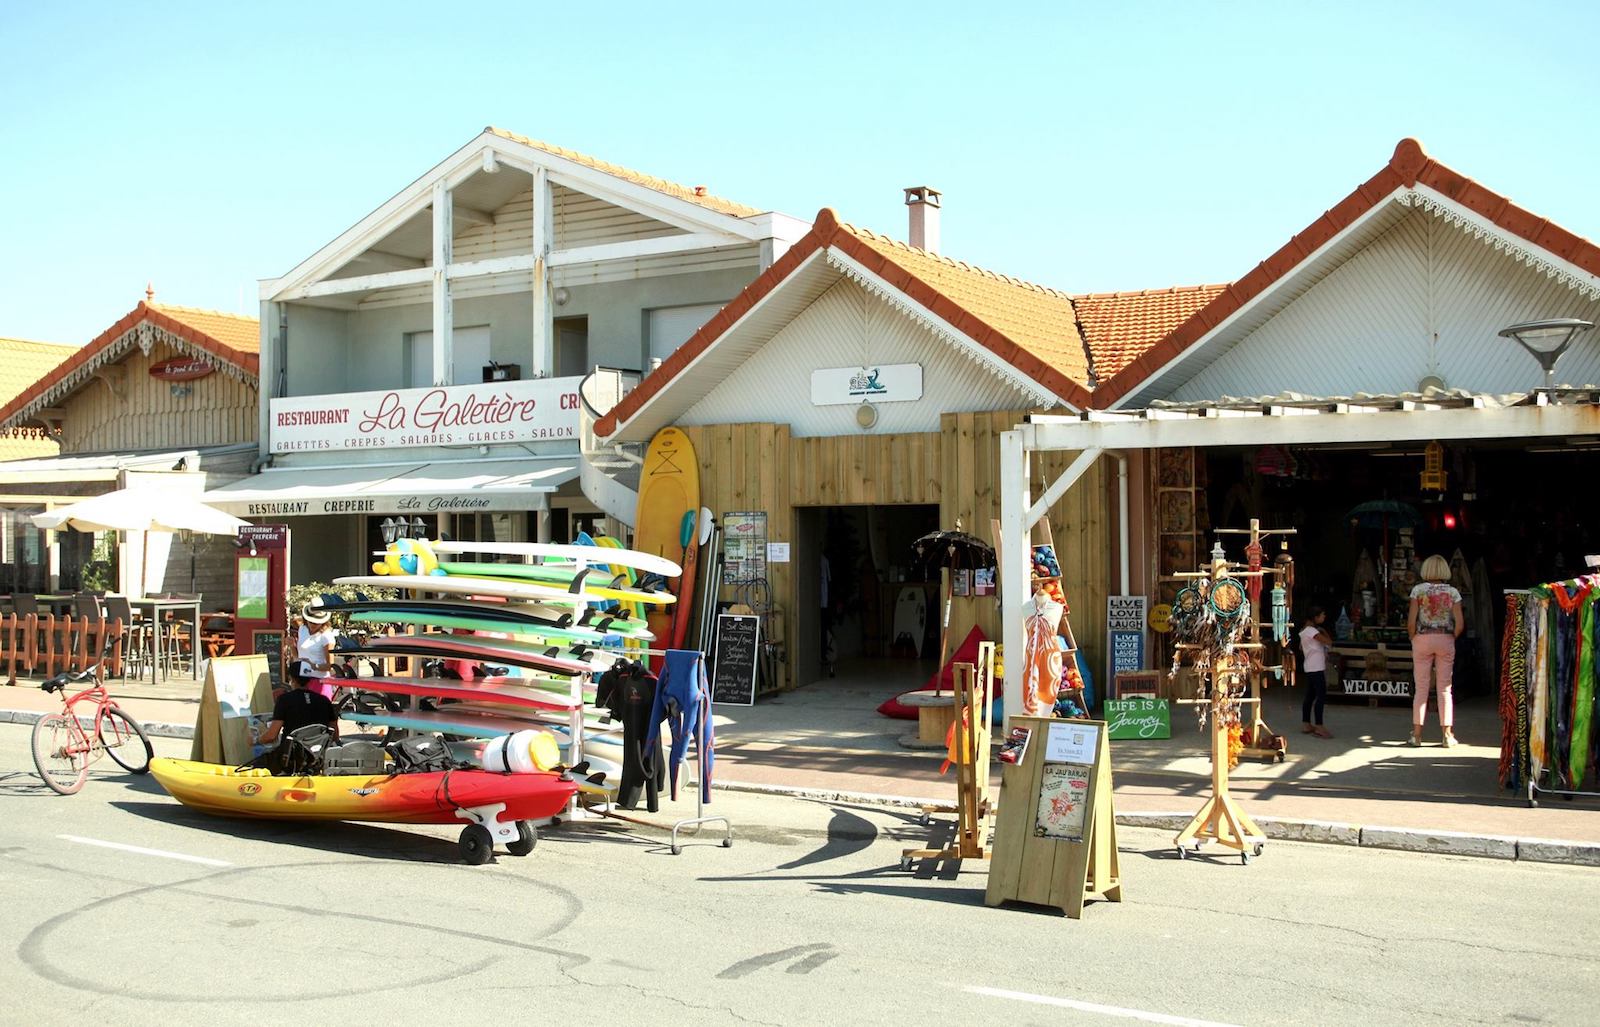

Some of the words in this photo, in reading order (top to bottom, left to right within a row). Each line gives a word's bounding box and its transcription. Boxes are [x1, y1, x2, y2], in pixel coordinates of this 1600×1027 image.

[277, 408, 350, 427] RESTAURANT
[358, 392, 405, 433] La
[413, 389, 536, 433] Galetière
[276, 439, 331, 451] GALETTES
[344, 436, 386, 448] CREPES
[400, 432, 453, 445] SALADES
[468, 430, 515, 442] GLACES
[531, 426, 574, 439] SALON
[248, 502, 310, 515] RESTAURANT
[324, 500, 375, 513] CREPERIE
[396, 496, 421, 509] La
[1110, 599, 1143, 607] LIVE
[1108, 620, 1143, 628] LAUGH
[1342, 679, 1410, 696] WELCOME
[1108, 701, 1137, 712] LIFE
[1141, 701, 1155, 711] IS
[1157, 700, 1167, 710] A
[1107, 712, 1166, 738] Journey
